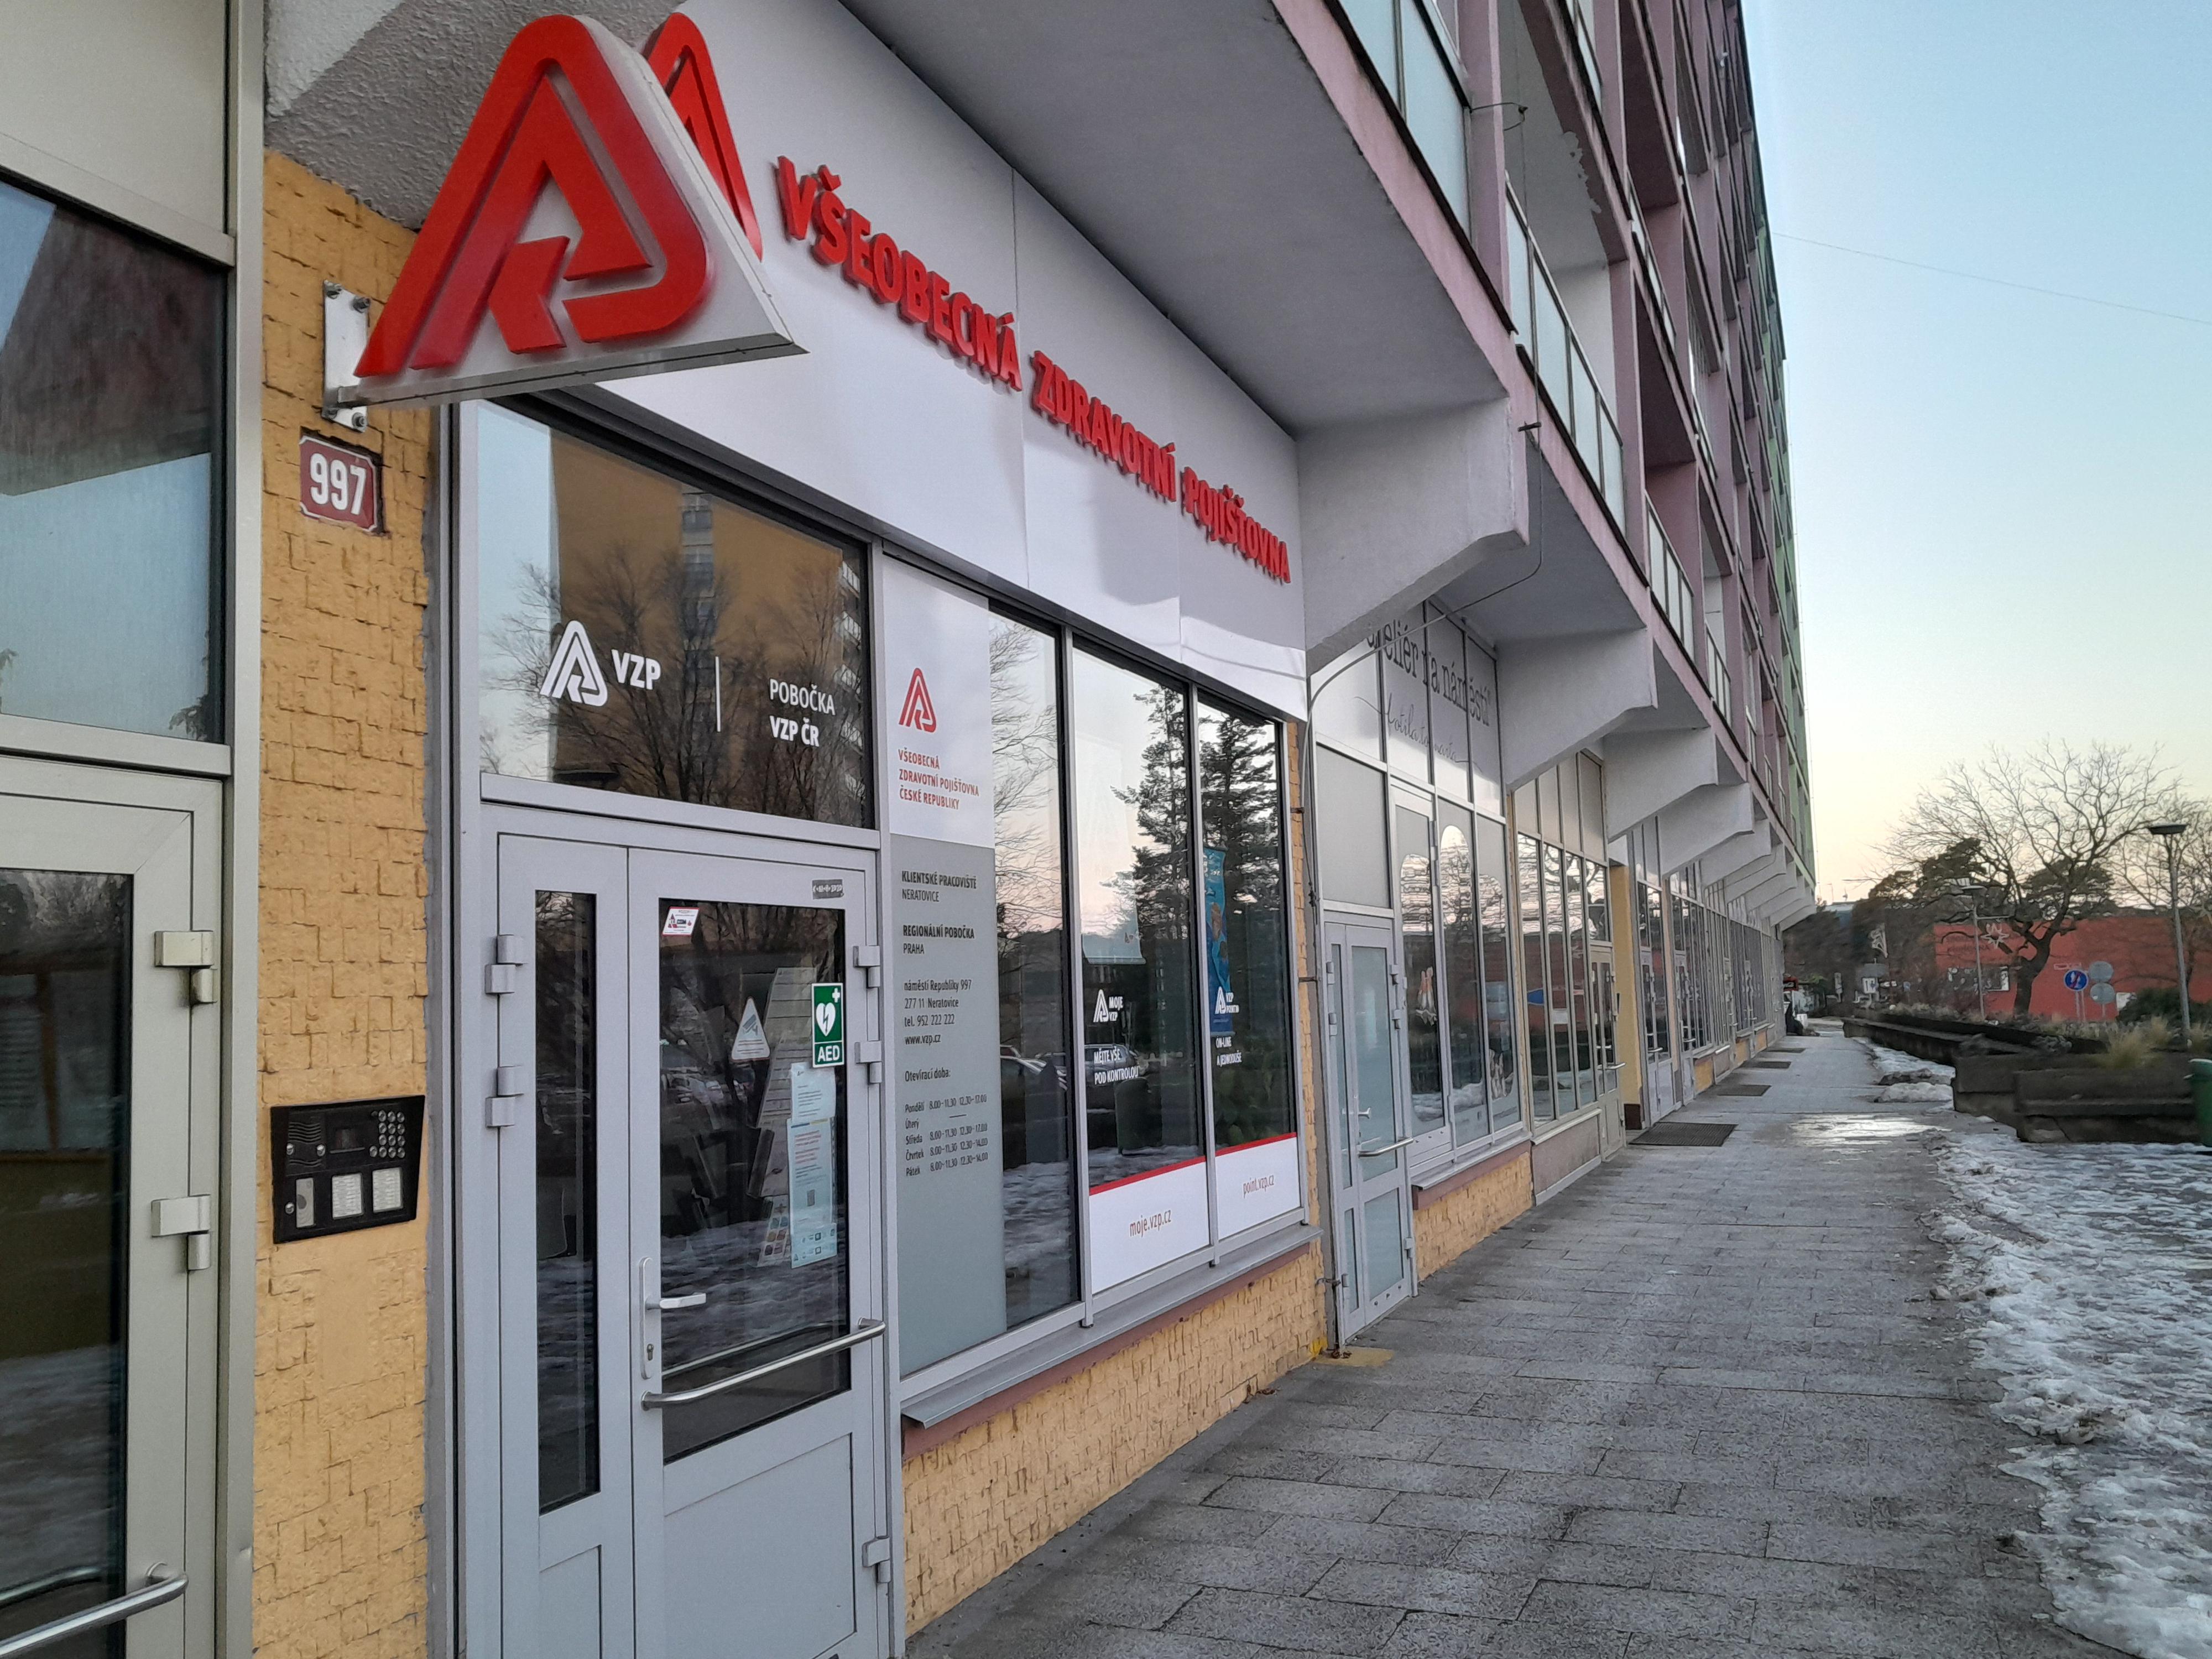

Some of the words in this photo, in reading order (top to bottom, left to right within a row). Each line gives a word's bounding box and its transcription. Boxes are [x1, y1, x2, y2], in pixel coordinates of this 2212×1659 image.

[774, 155, 1022, 392] VŠEOBECNÁ
[1030, 350, 1176, 503] ZDRAVOTNÍ
[1181, 466, 1290, 582] POJIŠŤOVNA
[310, 452, 367, 515] 997
[611, 649, 661, 690] VZP
[769, 678, 836, 716] POBOČKA
[769, 715, 798, 742] VZP
[801, 717, 820, 747] ČR
[898, 747, 940, 770] VŠEOBECNÁ
[899, 768, 938, 787] ZDRAVOTNÍ
[940, 777, 979, 796] POJIŠŤOVNA
[899, 784, 922, 802] ČESKÉ
[923, 791, 960, 810] REPUBLIKY
[901, 870, 937, 885] KLIENTSKÉ
[939, 874, 977, 889] PRACOVIŠTĚ
[901, 888, 940, 902] NERATOVICE
[902, 924, 943, 938] REGIONÁLNÍ
[945, 925, 975, 939] POBOČKA
[902, 942, 925, 954] PRAHA
[904, 979, 930, 991] náměstí
[930, 979, 959, 993] Republiky
[960, 979, 972, 990] 997
[904, 998, 916, 1009] 277
[919, 998, 925, 1008] 11
[927, 997, 959, 1009] Neratovice
[1109, 996, 1124, 1011] MOJE
[904, 1016, 915, 1027] tel.
[916, 1015, 928, 1026] 952
[931, 1014, 942, 1025] 222
[944, 1014, 955, 1024] 222
[1109, 1011, 1118, 1021] VZP
[905, 1034, 941, 1046] www.vzp.cz
[817, 1045, 841, 1062] AED
[1094, 1048, 1110, 1065] MĚJTE
[1110, 1046, 1121, 1062] VŠE
[905, 1068, 933, 1082] Otevírací
[934, 1067, 951, 1079] doba:
[1094, 1072, 1107, 1085] POD
[1107, 1065, 1140, 1083] KONTROLOU
[905, 1101, 925, 1113] Pondělí
[905, 1118, 919, 1130] Úterý
[905, 1134, 923, 1145] Středa
[905, 1149, 925, 1161] Čtvrtek
[906, 1167, 921, 1176] Pátek
[1243, 1174, 1275, 1198] point.vzp.cz
[1129, 1209, 1172, 1238] moje.vzp.cz
